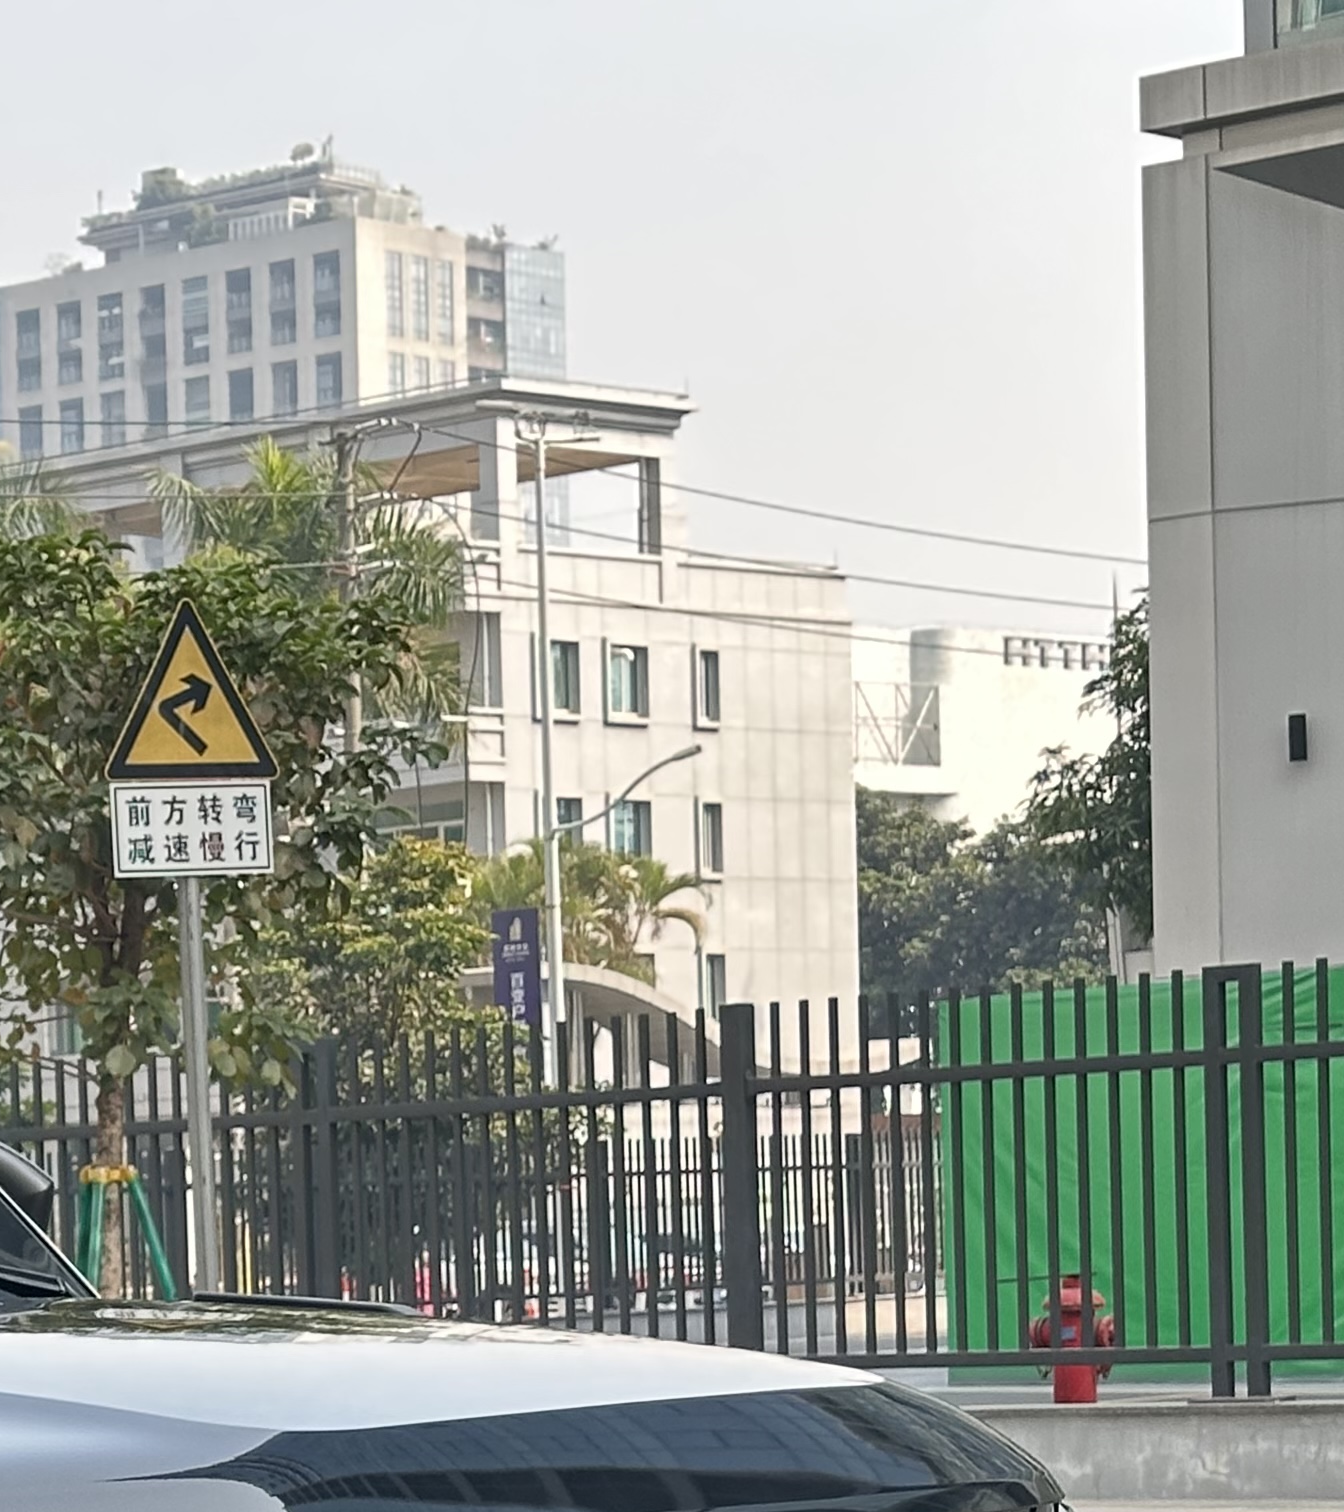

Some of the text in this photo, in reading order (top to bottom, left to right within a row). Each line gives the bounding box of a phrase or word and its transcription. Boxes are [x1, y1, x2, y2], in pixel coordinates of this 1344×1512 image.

[125, 793, 257, 828] 前方转弯
[127, 830, 261, 865] 减速慢行
